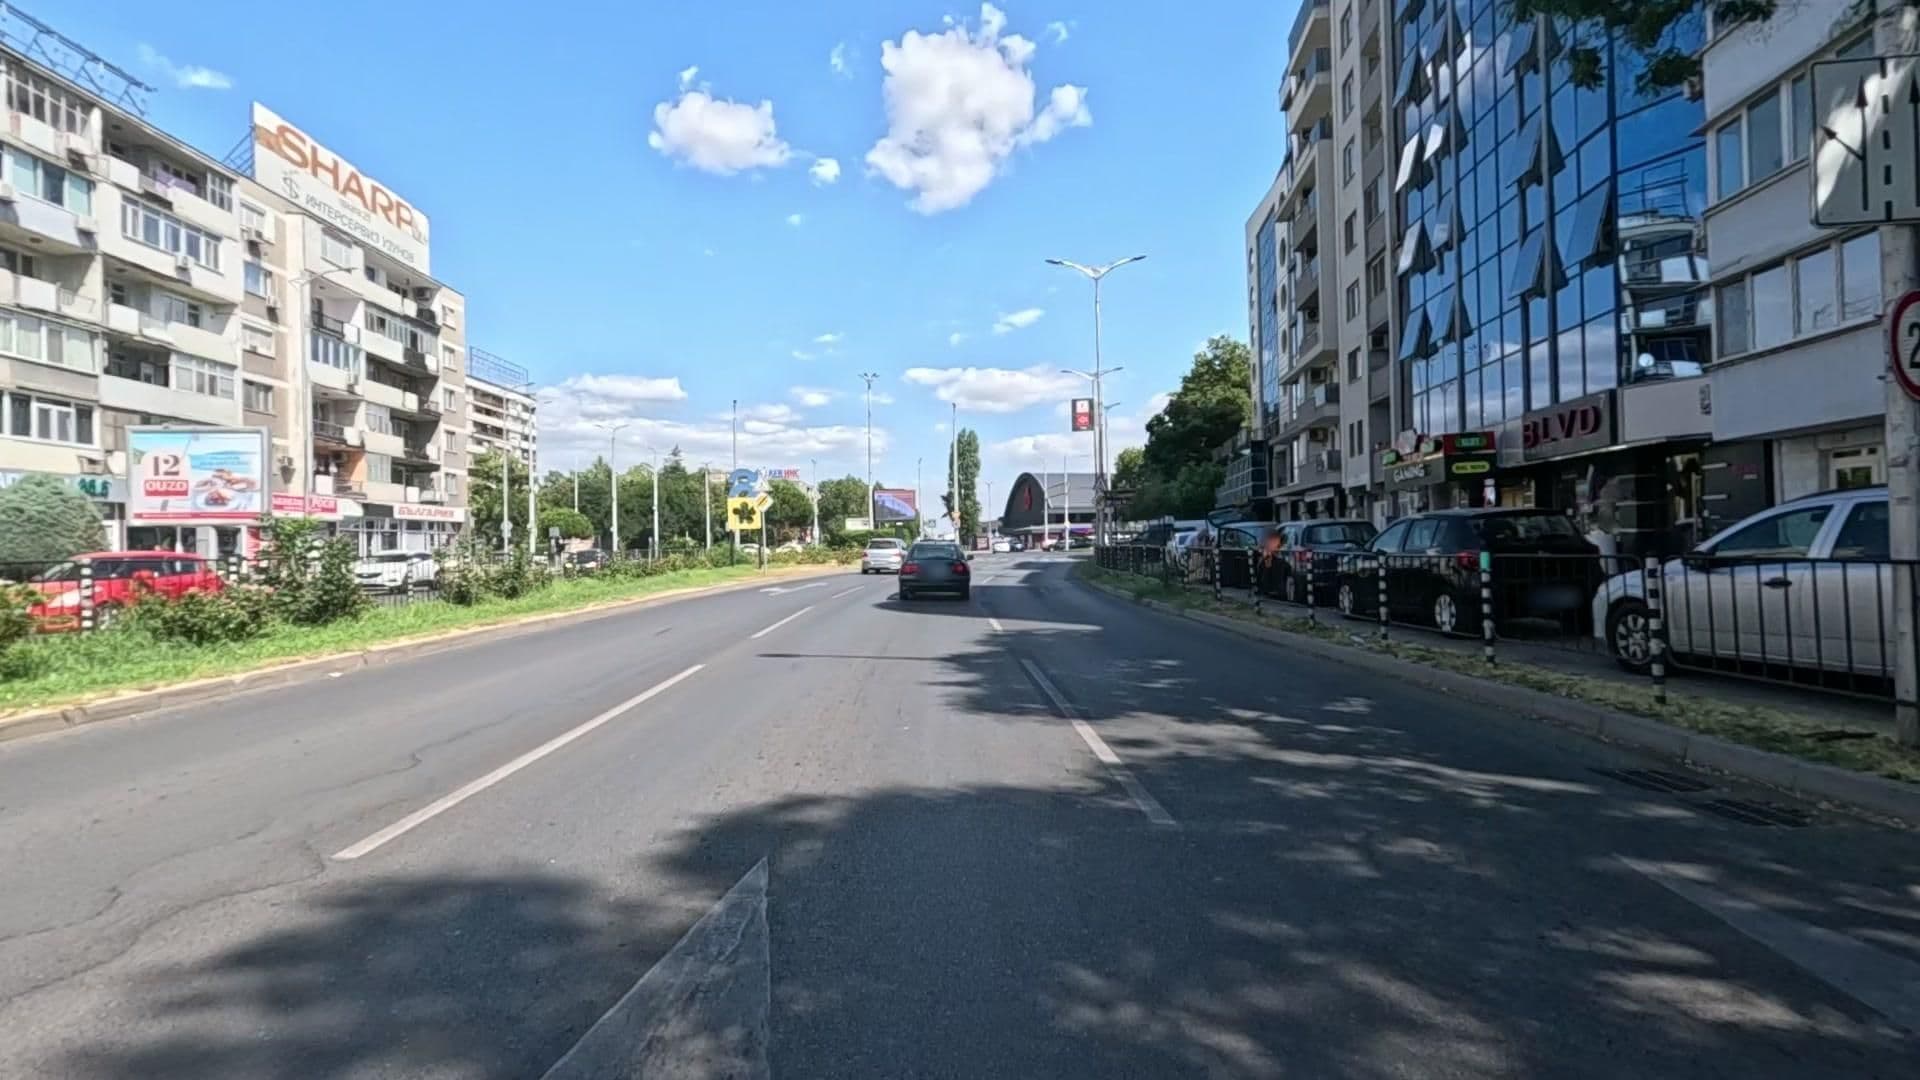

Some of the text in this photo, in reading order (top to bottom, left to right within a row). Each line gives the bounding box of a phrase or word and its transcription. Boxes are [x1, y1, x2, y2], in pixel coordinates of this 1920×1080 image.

[276, 124, 414, 230] SHARP
[1523, 405, 1602, 449] BLVD
[146, 481, 185, 492] OUZO
